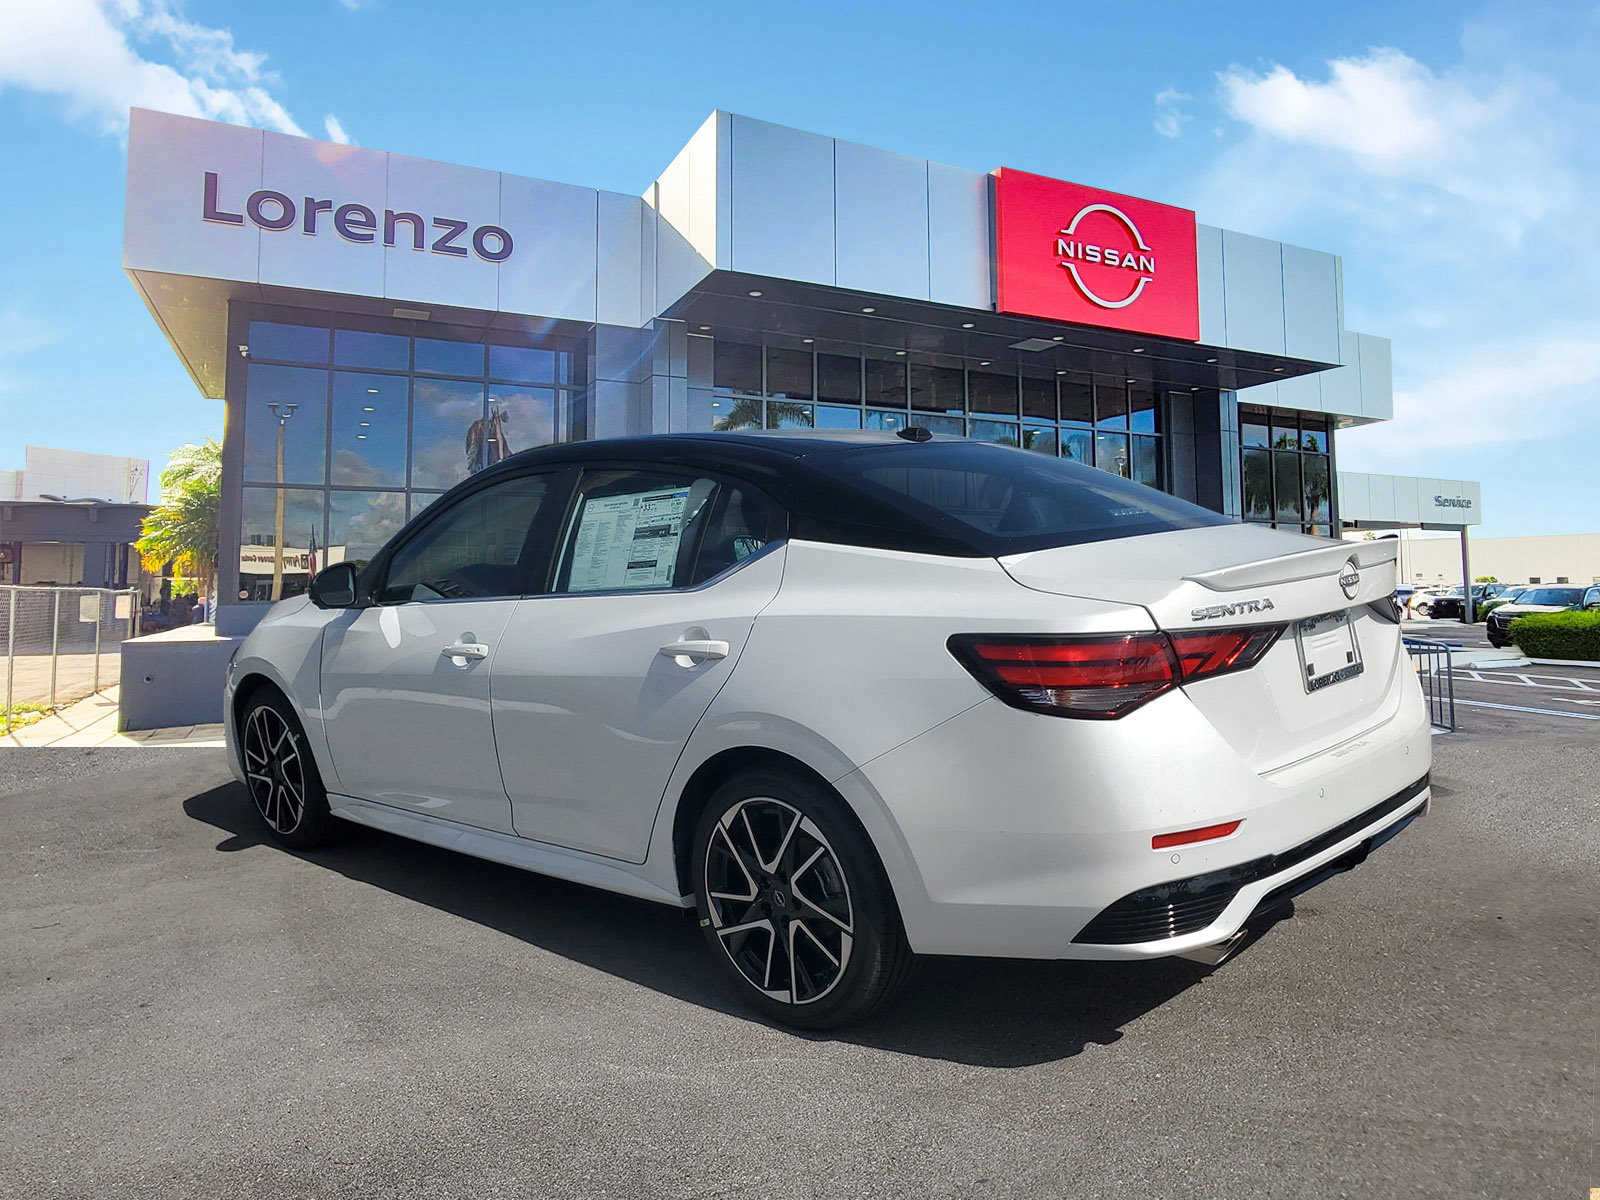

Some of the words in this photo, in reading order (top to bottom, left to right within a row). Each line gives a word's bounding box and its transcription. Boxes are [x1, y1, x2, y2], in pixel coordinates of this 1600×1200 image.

[202, 171, 514, 263] Lorenzo
[1057, 238, 1155, 273] NISSAN
[1434, 495, 1472, 509] Service
[1191, 598, 1275, 622] SENTRA
